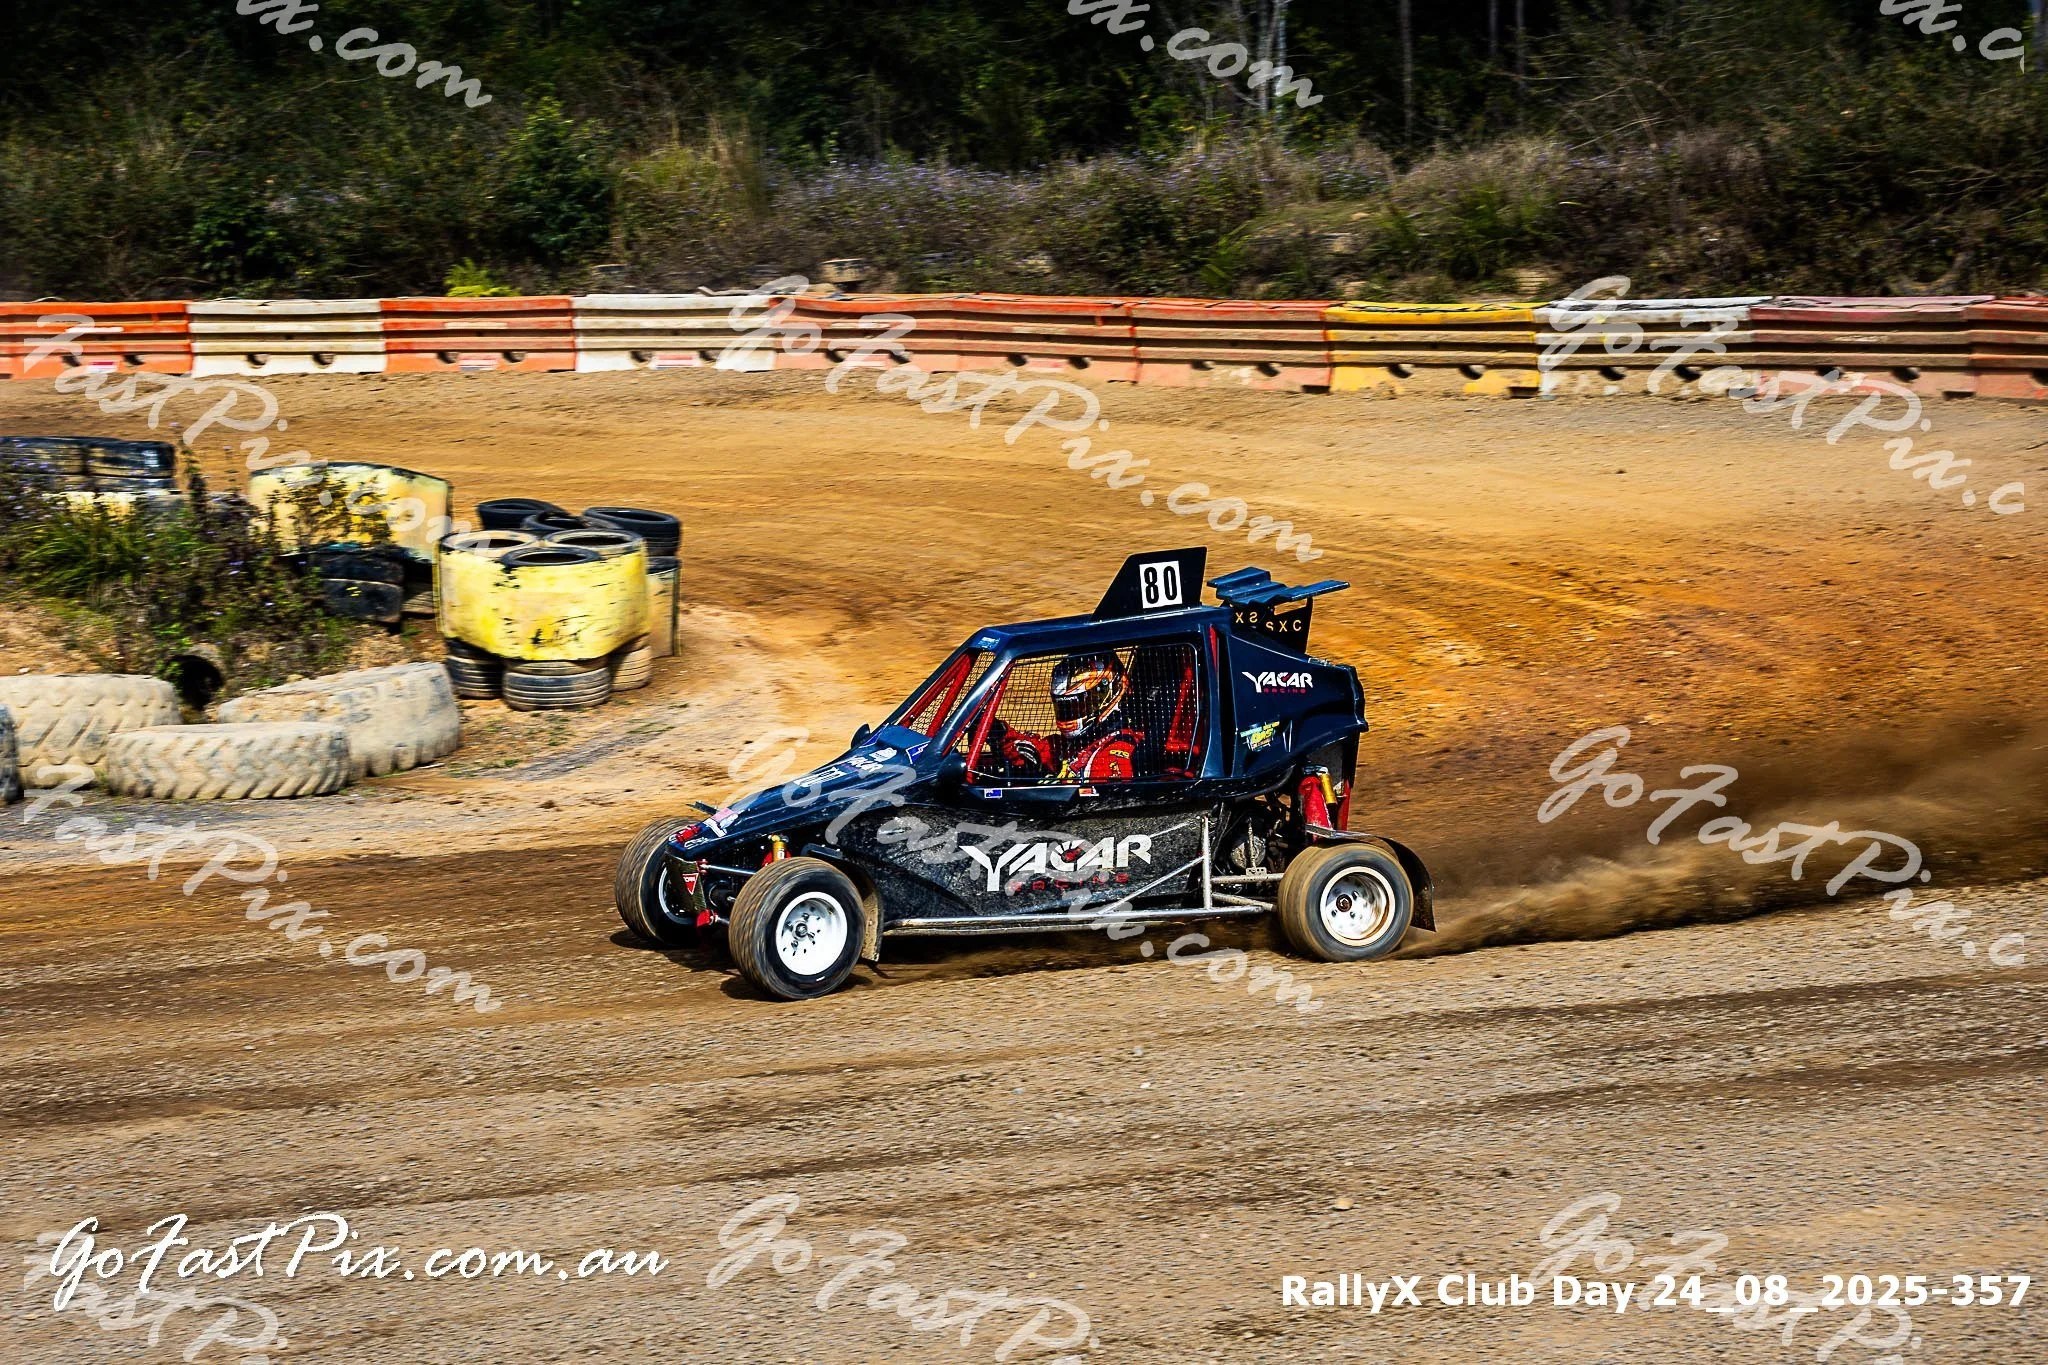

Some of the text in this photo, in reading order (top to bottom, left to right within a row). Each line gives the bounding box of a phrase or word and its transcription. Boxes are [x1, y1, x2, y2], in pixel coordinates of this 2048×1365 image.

[1143, 565, 1178, 604] 80
[1241, 671, 1313, 693] YACAR
[959, 833, 1152, 892] YACAR
